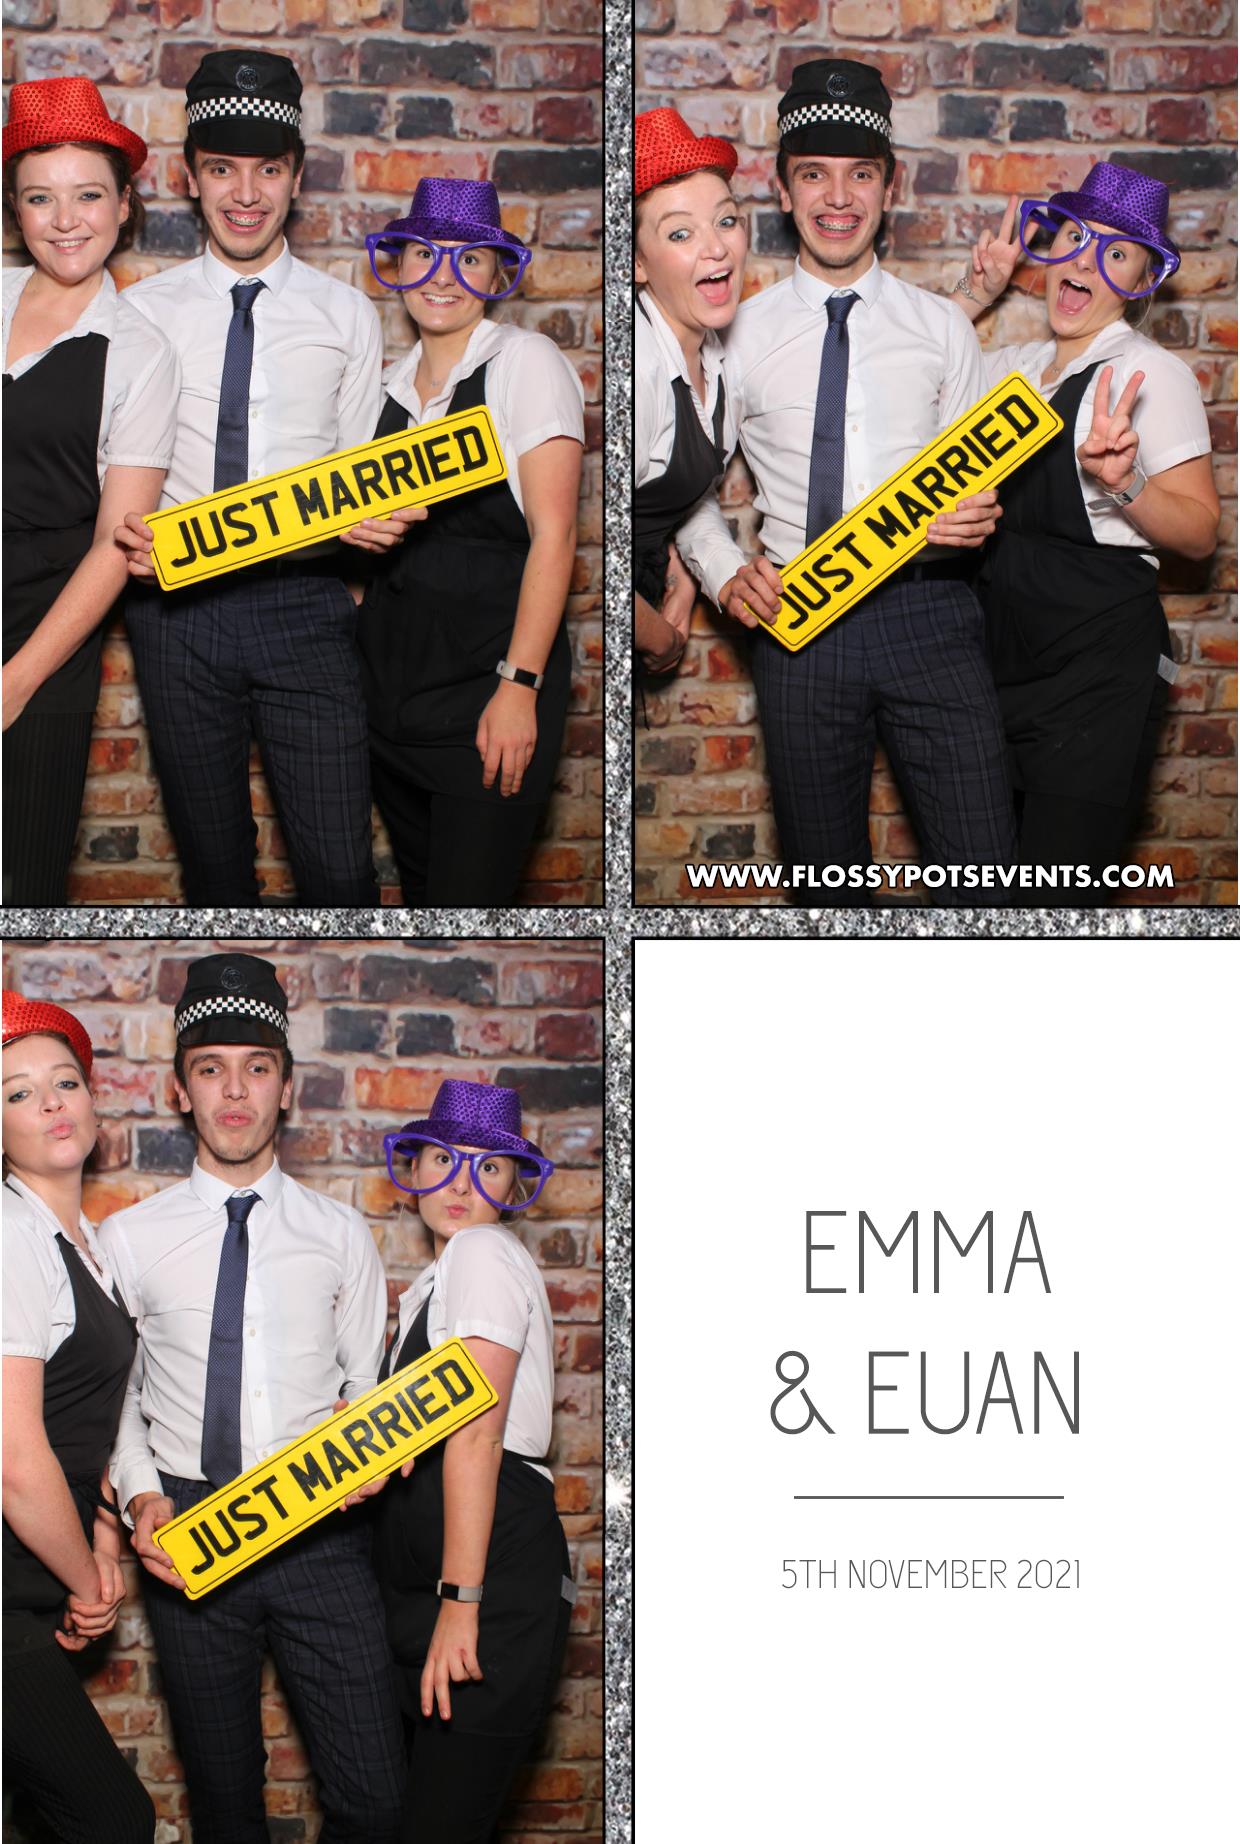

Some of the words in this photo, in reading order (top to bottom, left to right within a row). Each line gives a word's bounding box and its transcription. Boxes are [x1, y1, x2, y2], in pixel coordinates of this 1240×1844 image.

[171, 491, 281, 568] JUST
[291, 425, 489, 526] MARRIED
[780, 532, 873, 630] JUST
[863, 393, 1040, 550] MARRIED
[190, 1475, 289, 1575] JUST
[287, 1359, 475, 1502] MARRIED
